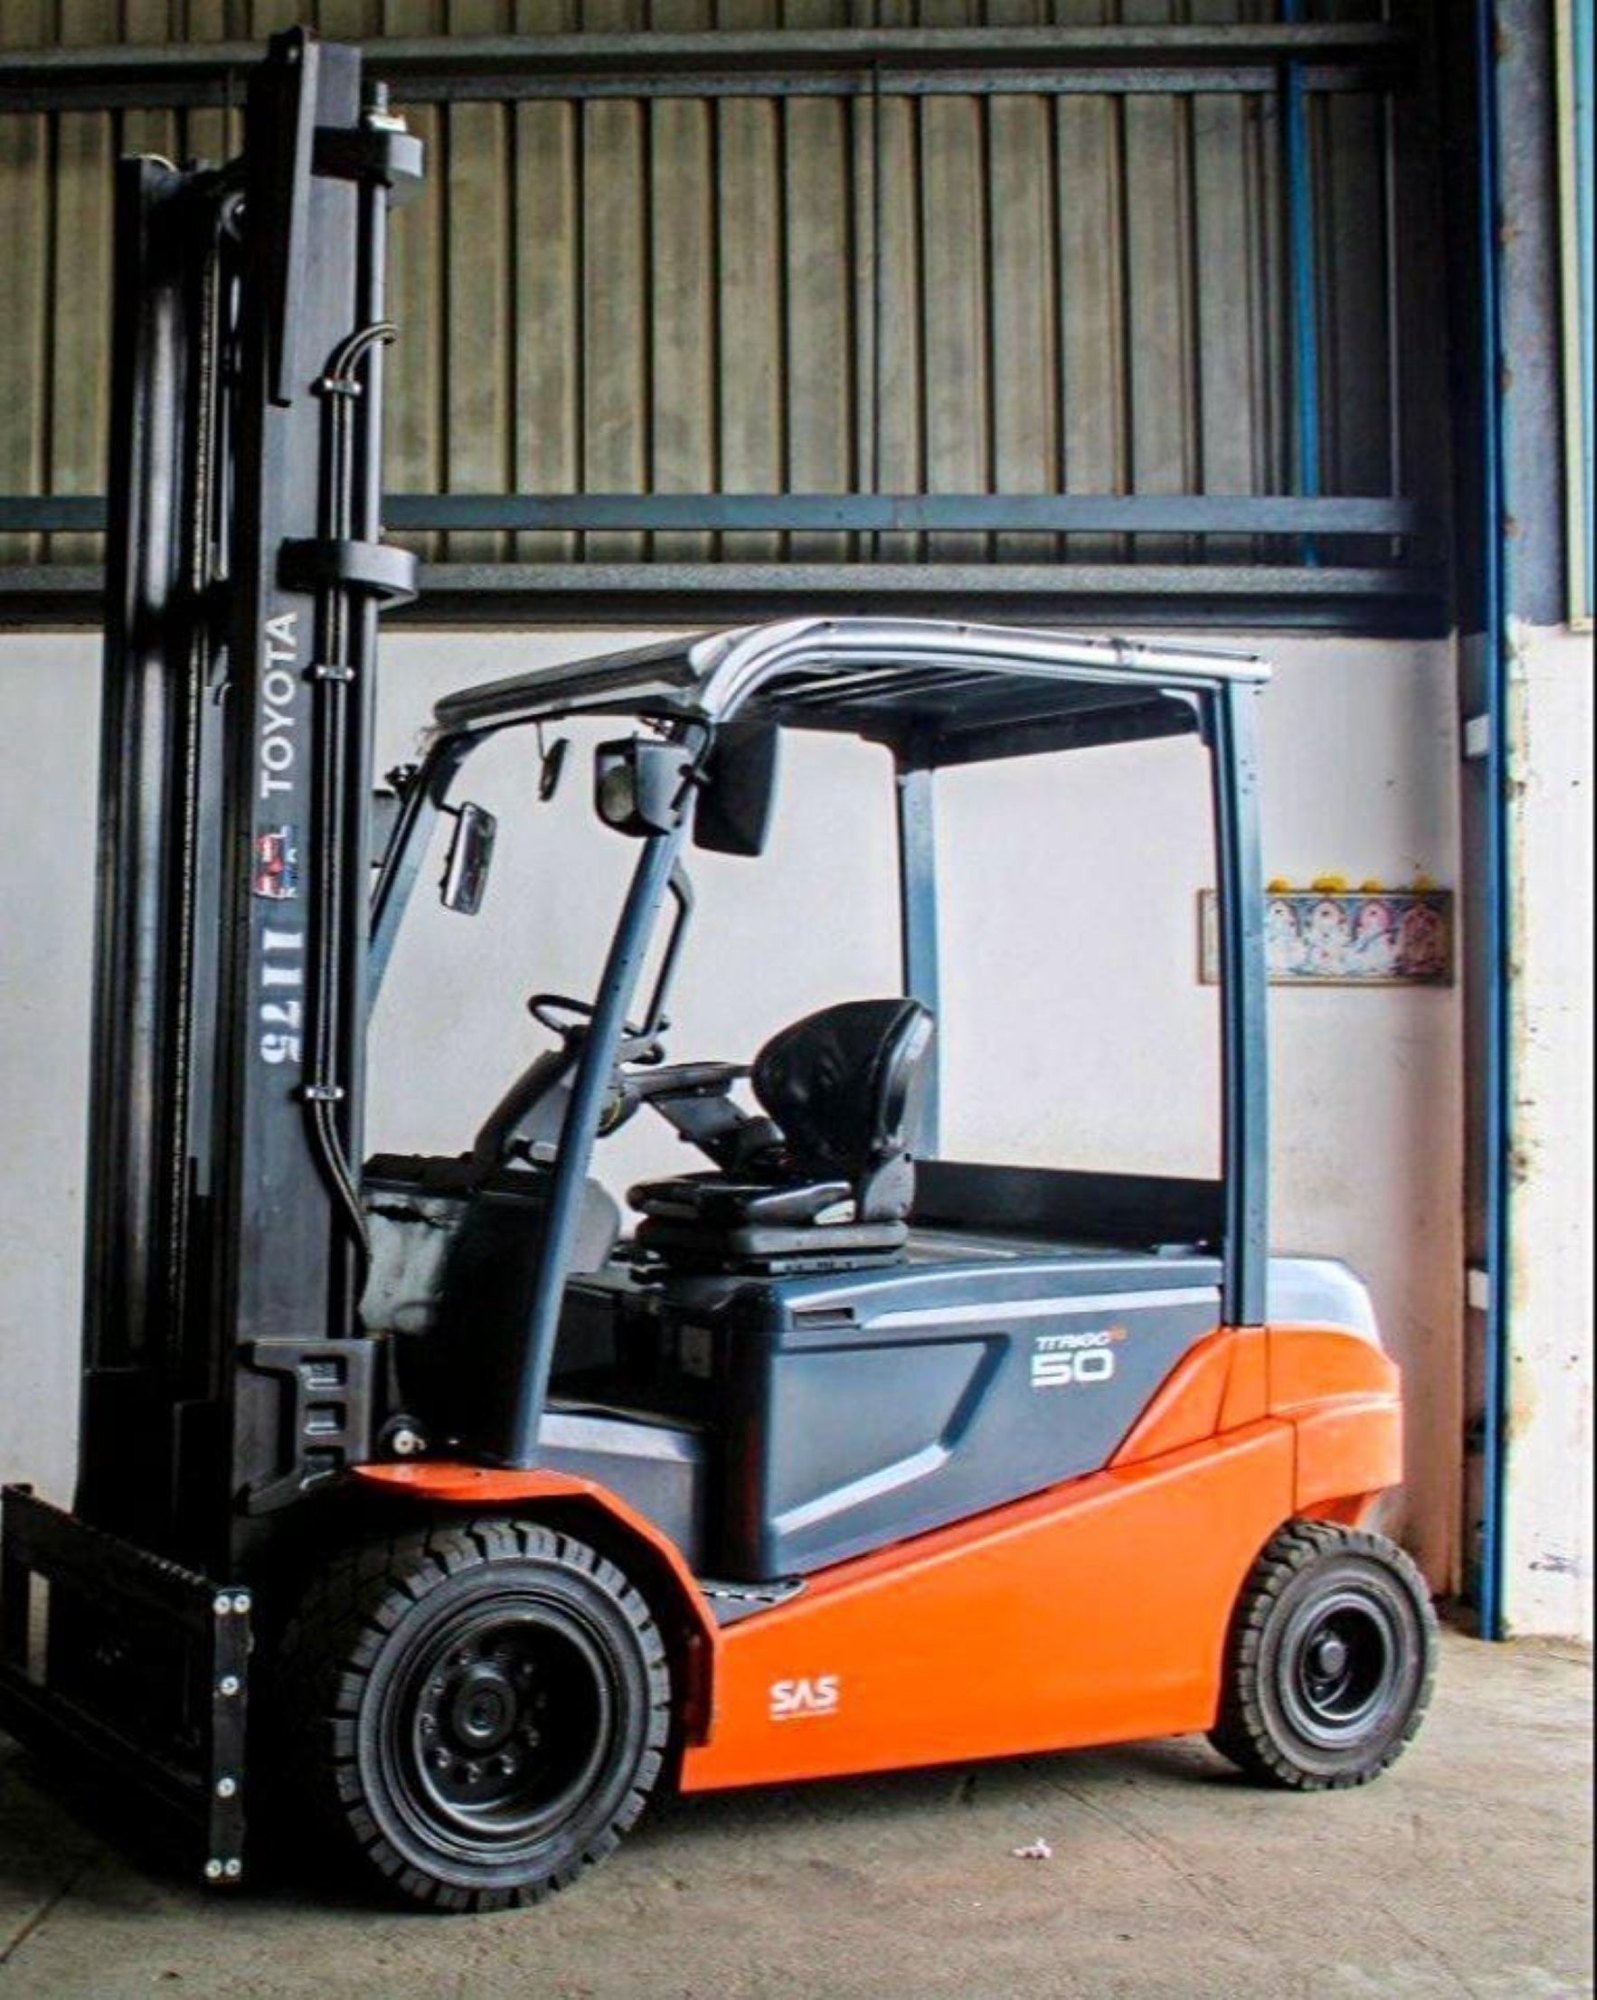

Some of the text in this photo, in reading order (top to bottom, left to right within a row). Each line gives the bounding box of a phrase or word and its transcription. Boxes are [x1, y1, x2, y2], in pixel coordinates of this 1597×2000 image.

[261, 611, 297, 798] TOYOTA
[260, 929, 303, 1064] 1175
[1031, 1348, 1114, 1387] 50
[769, 1674, 840, 1711] SAS
